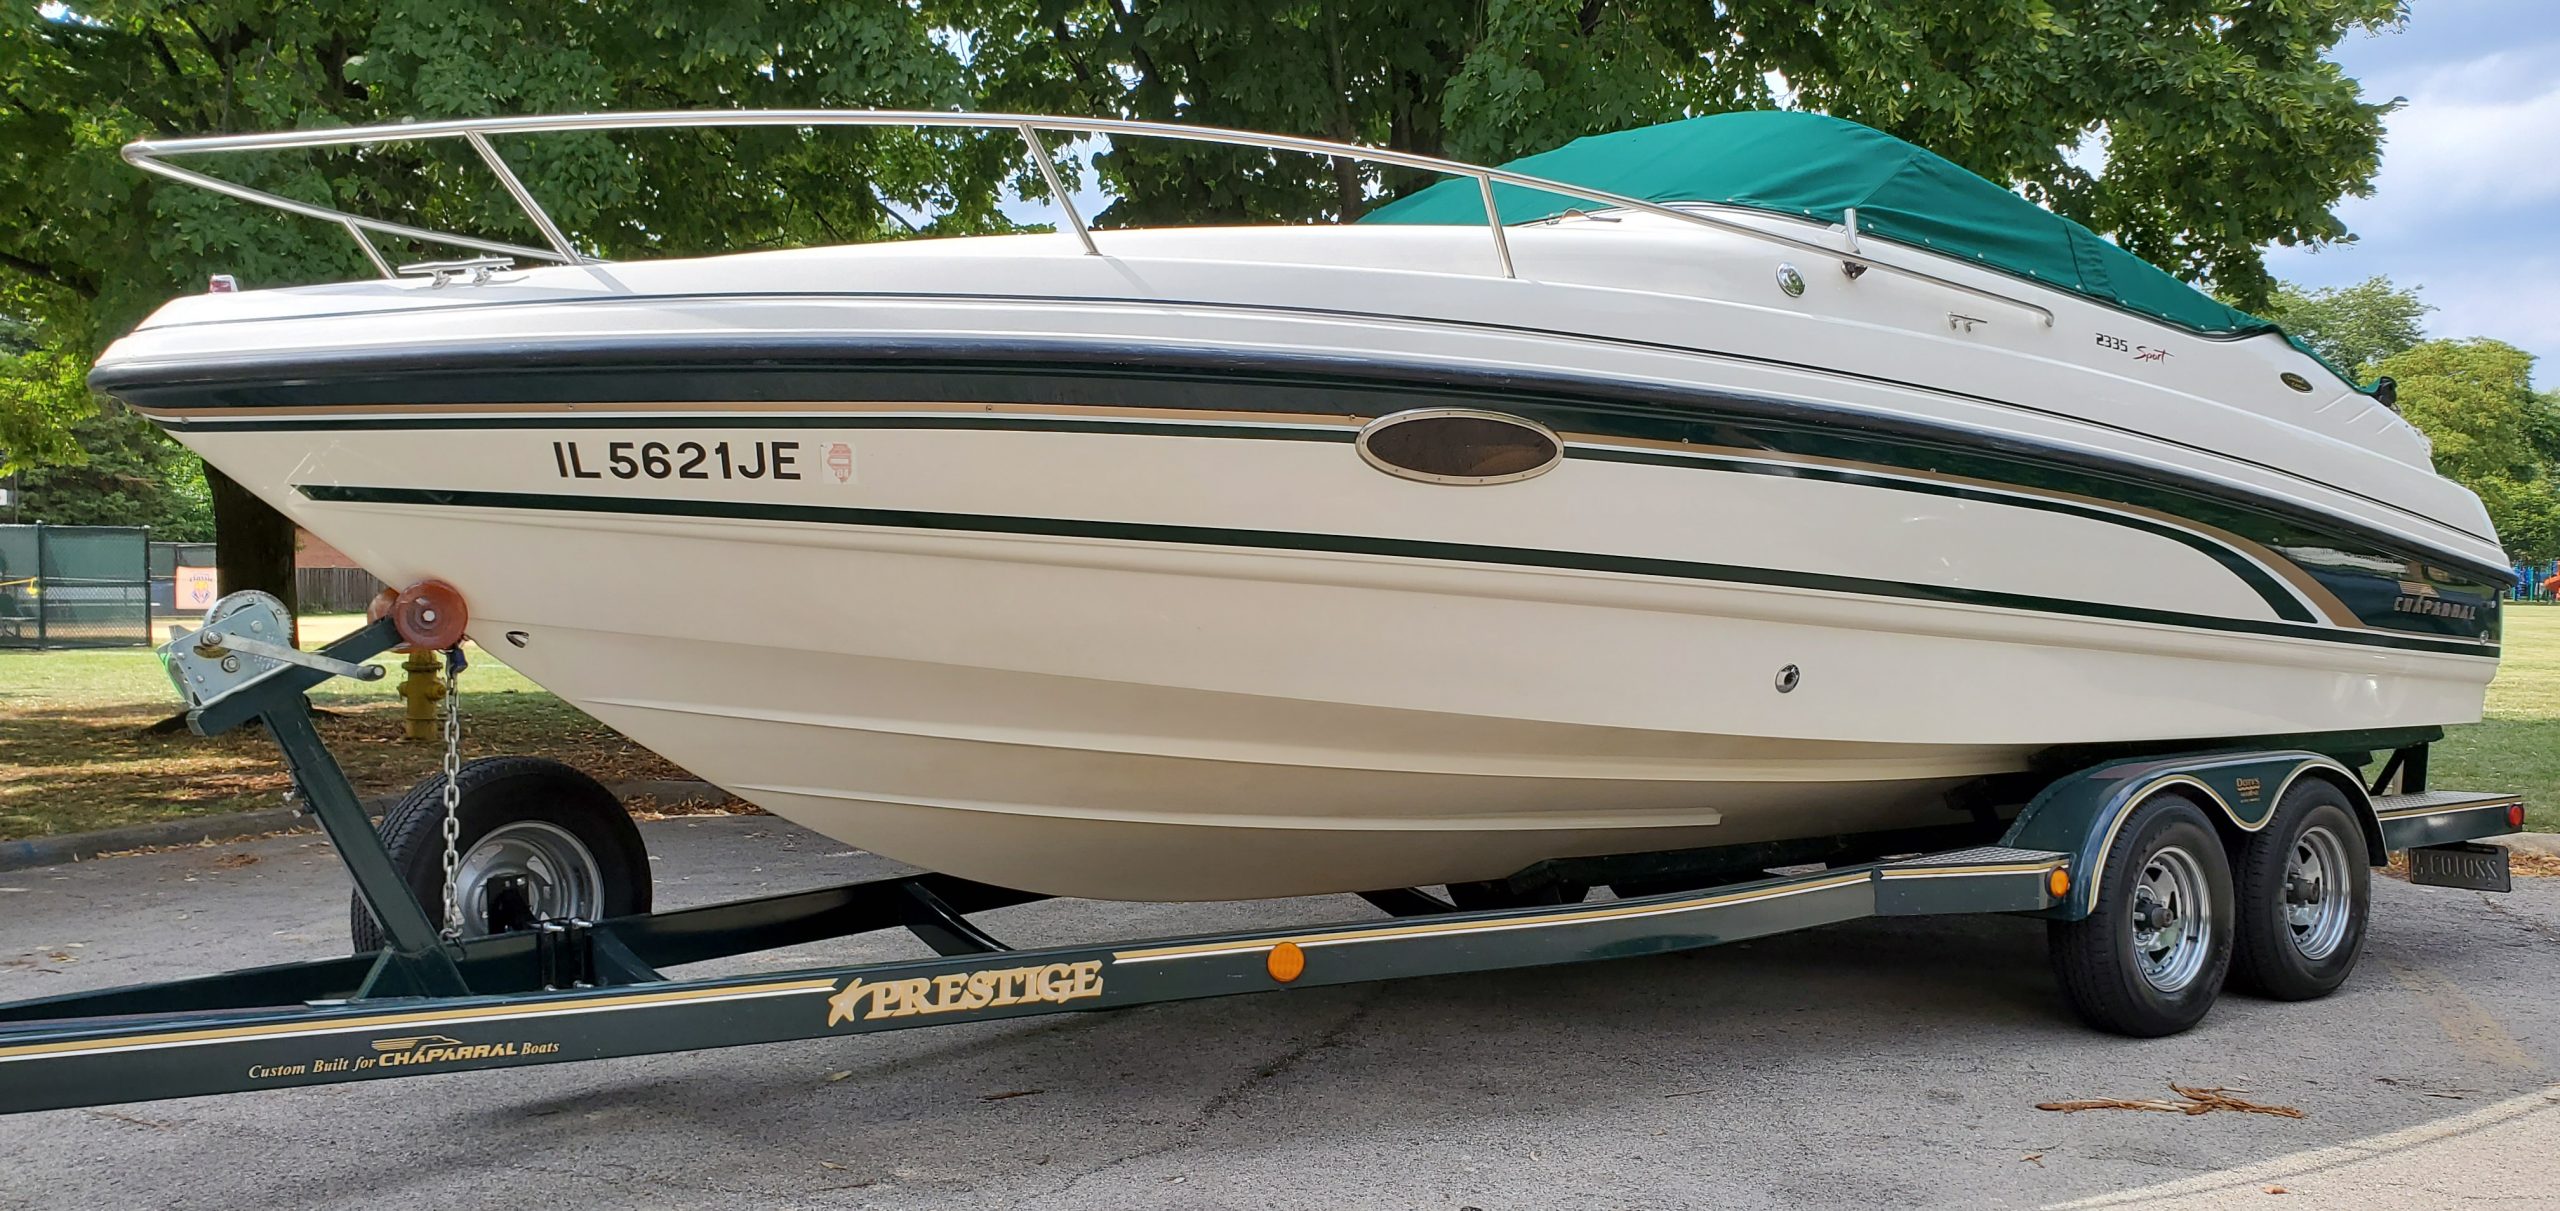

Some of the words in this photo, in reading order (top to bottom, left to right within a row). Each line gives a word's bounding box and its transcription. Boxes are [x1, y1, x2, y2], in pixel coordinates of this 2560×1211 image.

[2095, 332, 2128, 353] 2335
[2133, 345, 2176, 366] Sport
[2393, 596, 2476, 620] CHAPARRAL
[863, 960, 1104, 1021] PRESTIGE
[248, 1065, 305, 1079] Custom
[312, 1057, 350, 1073] Built
[351, 1056, 376, 1072] for
[378, 1042, 518, 1067] CHAPARRAL
[520, 1041, 561, 1056] Boats
